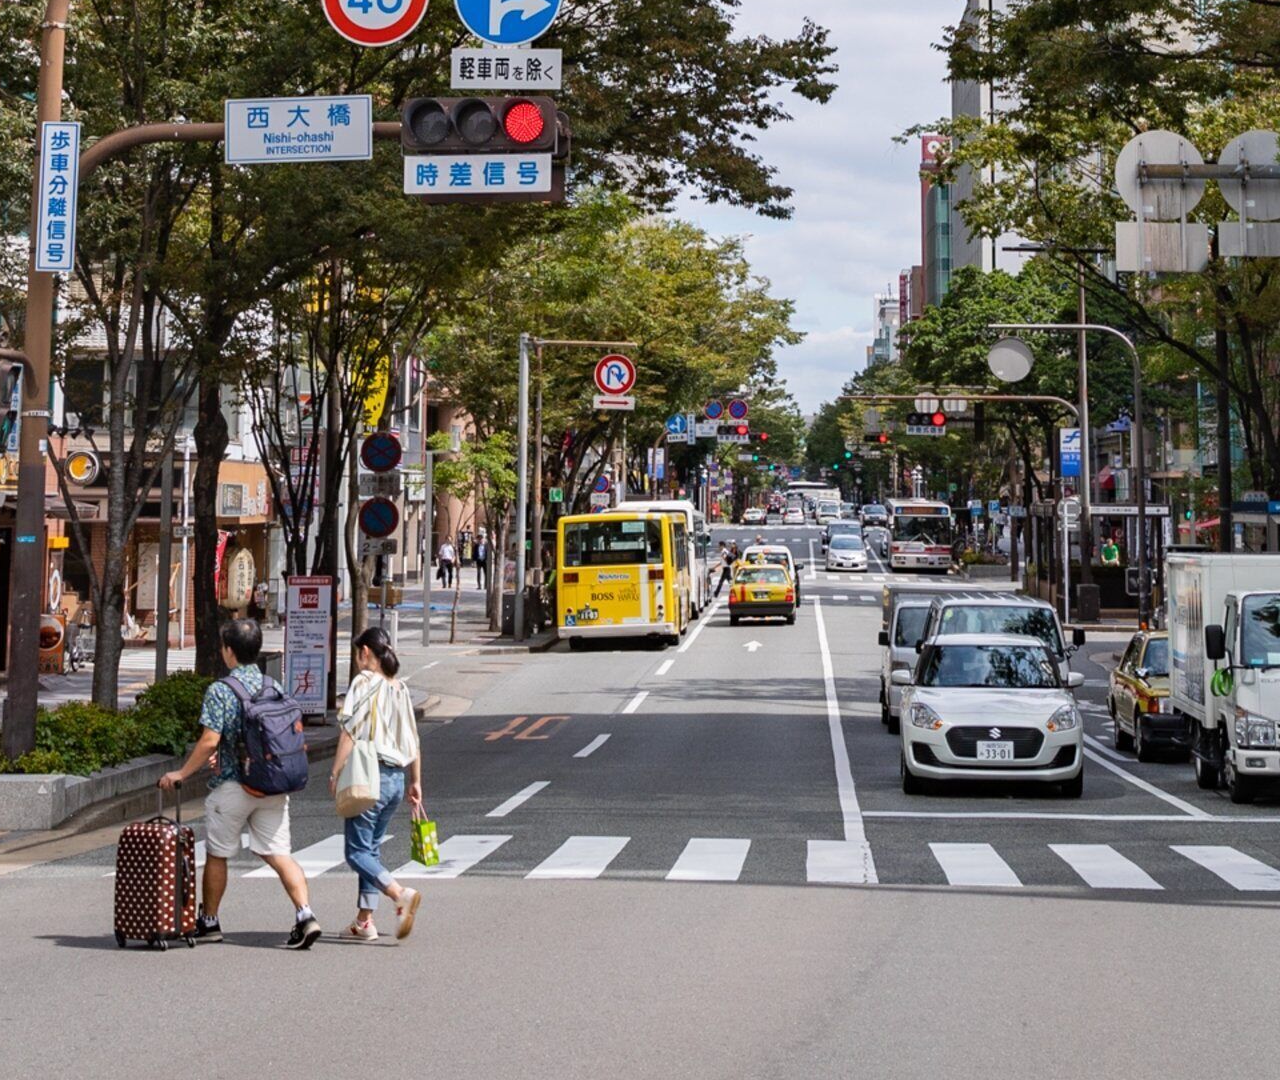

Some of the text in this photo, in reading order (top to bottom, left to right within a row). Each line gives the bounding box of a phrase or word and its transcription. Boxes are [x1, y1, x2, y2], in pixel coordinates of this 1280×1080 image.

[459, 56, 554, 82] 軽車両を除く
[246, 103, 351, 129] 西大橋
[263, 130, 335, 145] Nishi-ohashi
[265, 144, 331, 155] INTERSECTION
[416, 160, 540, 187] 時差信号
[45, 130, 71, 264] 歩車分離信号
[591, 592, 615, 601] BOSS
